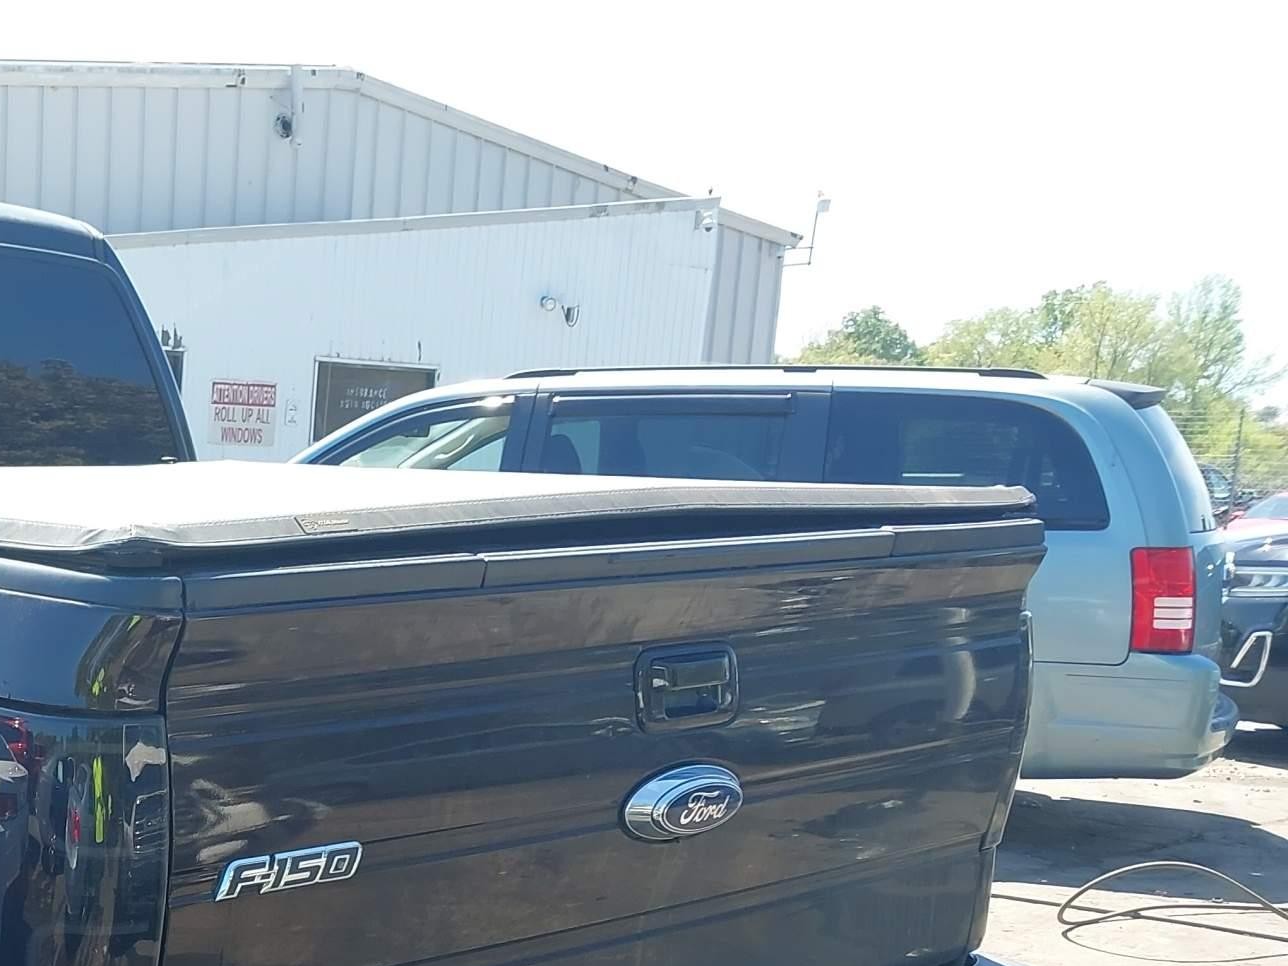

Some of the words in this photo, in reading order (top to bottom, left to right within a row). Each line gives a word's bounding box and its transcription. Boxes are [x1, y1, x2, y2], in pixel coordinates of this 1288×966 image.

[214, 384, 248, 403] ATTENTION
[249, 386, 275, 404] DRIVERS
[214, 406, 237, 422] ROLL
[241, 407, 254, 423] UP
[255, 408, 271, 425] ALL
[221, 427, 263, 444] WINDOWS
[679, 790, 731, 825] Ford
[215, 841, 363, 902] F-150
